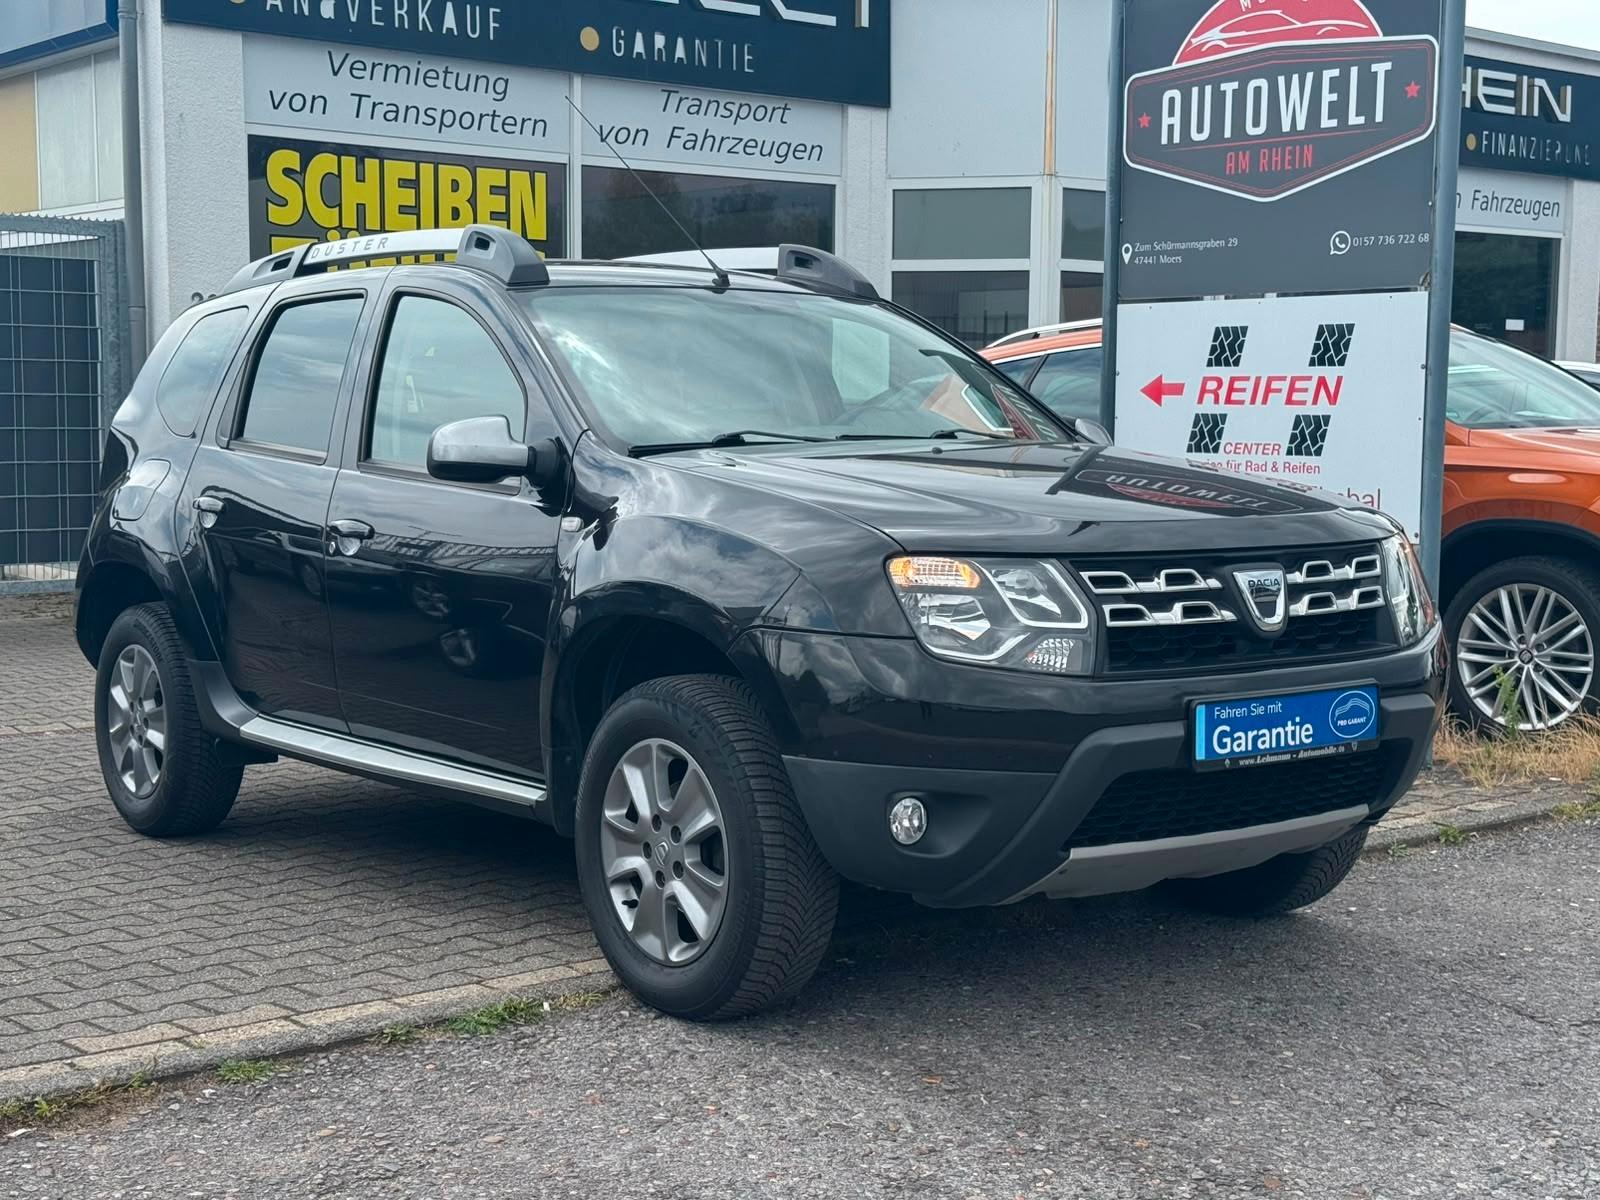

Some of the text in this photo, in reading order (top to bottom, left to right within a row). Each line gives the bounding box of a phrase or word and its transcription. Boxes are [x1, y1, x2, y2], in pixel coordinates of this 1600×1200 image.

[612, 26, 755, 73] GARANTIE
[328, 51, 510, 101] Vermietung
[269, 90, 549, 137] von Transportern
[660, 89, 791, 125] Transport
[1161, 61, 1393, 145] AUTOWELT
[599, 124, 823, 164] von Fahrzeugen
[1226, 144, 1313, 174] AM RHEIN
[266, 149, 547, 241] SCHEIBEN
[1471, 190, 1560, 221] Fahrzeugen
[311, 237, 390, 259] DUSTER
[1134, 238, 1238, 252] Zum Schürmannsgraben 29
[1352, 233, 1430, 246] 0157 736 722 68
[1134, 255, 1182, 264] 47441 Moers
[1196, 375, 1344, 406] REIFEN
[1223, 442, 1281, 455] CENTER
[1226, 460, 1241, 472] für
[1245, 460, 1267, 473] Rad
[1270, 462, 1279, 472] &
[1283, 462, 1320, 474] Reifen
[1248, 578, 1280, 587] DACIA
[1214, 701, 1282, 719] Fahren Sie mit
[1348, 716, 1366, 725] GARANT
[1213, 716, 1313, 754] Garantie
